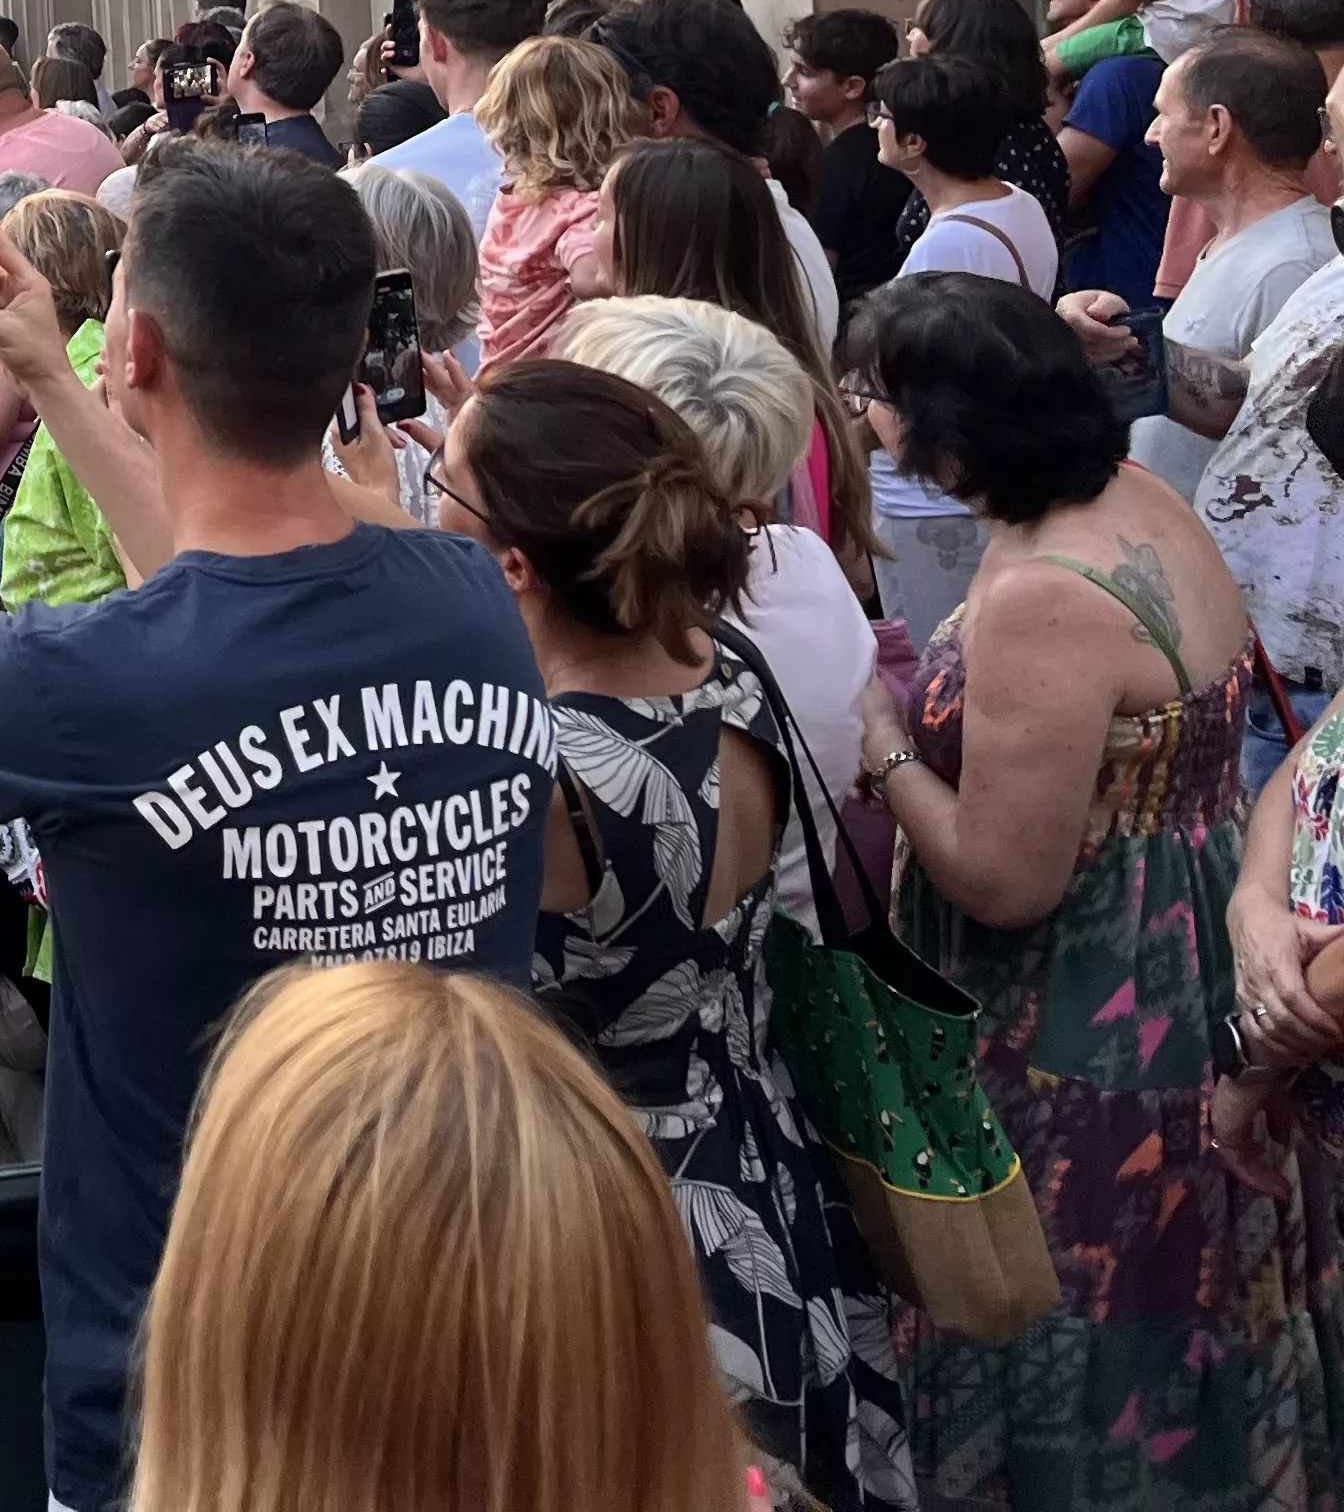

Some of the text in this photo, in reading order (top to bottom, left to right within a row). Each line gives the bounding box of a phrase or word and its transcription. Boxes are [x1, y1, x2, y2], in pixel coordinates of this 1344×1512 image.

[133, 725, 284, 850] DEUS
[279, 694, 357, 773] EX
[222, 773, 532, 879] MOTORCYCLES
[252, 842, 508, 920] PARTS AND SERVICE
[253, 885, 508, 951] CARRETERA SANTA EULARIA
[427, 929, 476, 961] IBIZA
